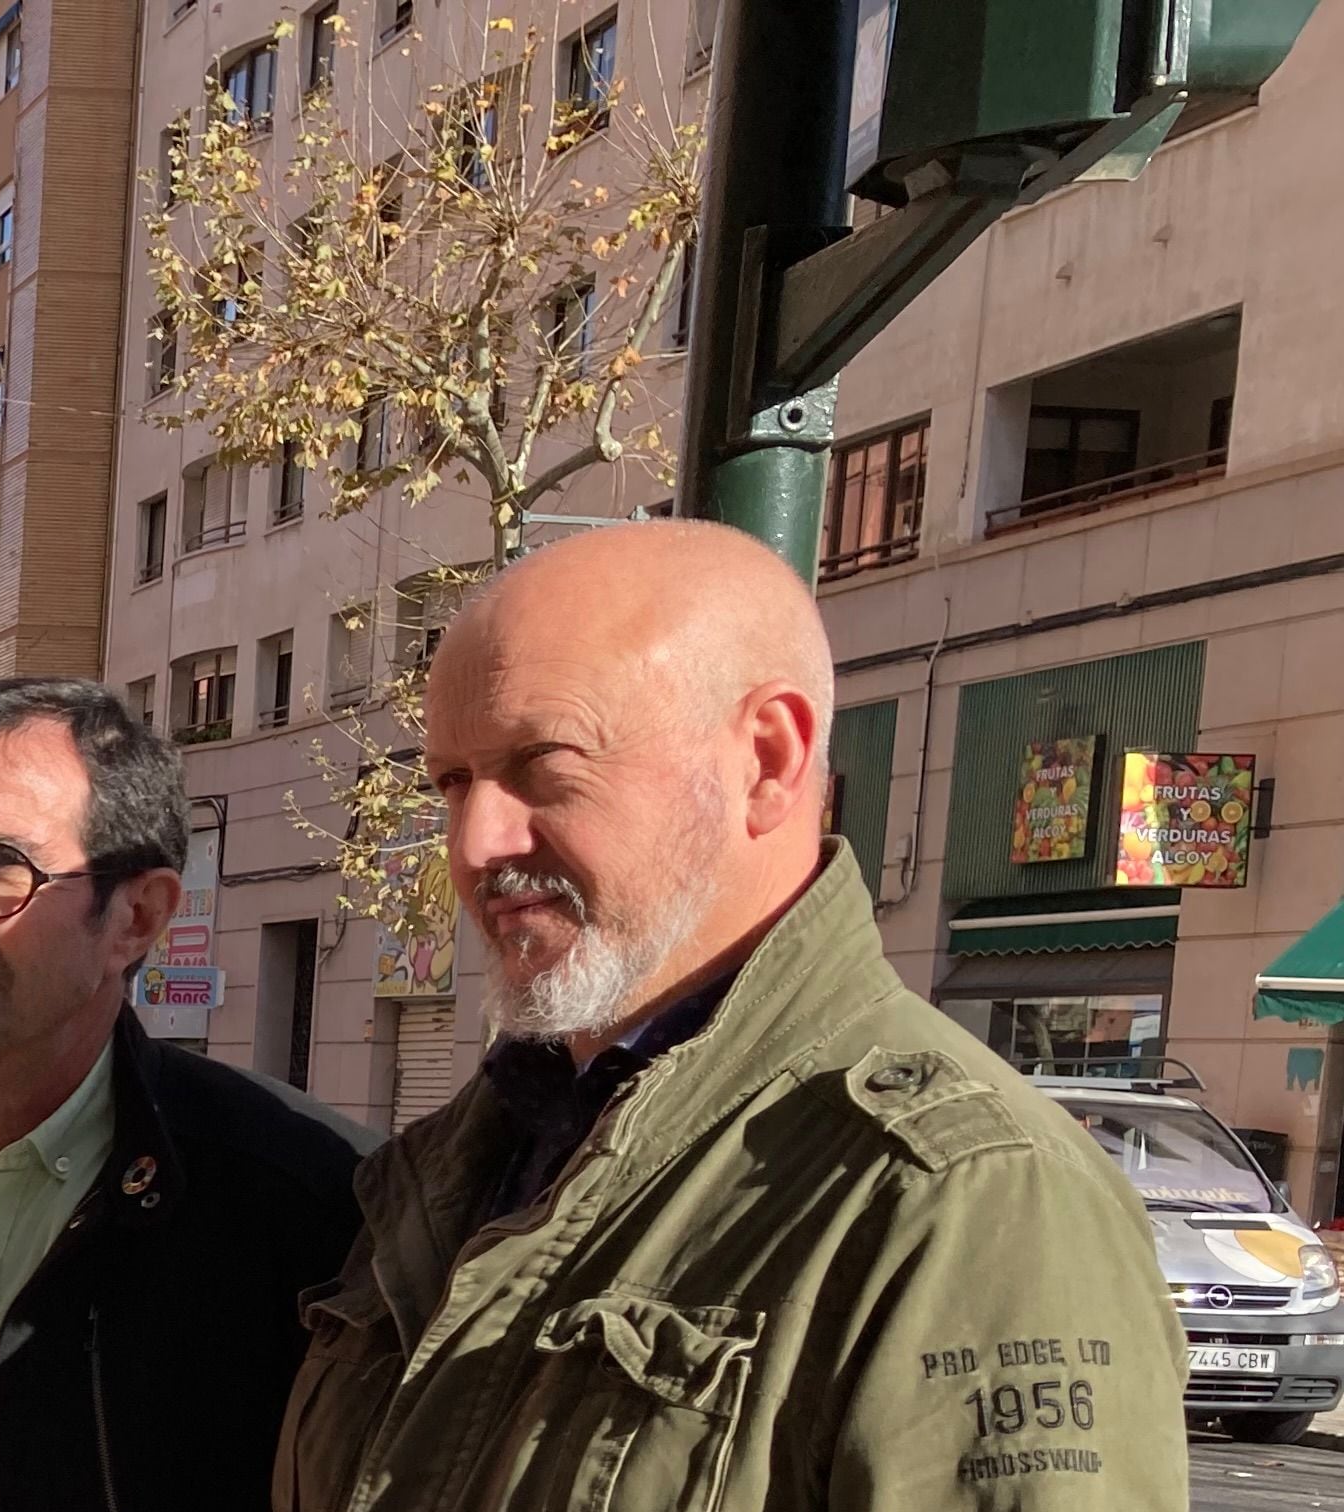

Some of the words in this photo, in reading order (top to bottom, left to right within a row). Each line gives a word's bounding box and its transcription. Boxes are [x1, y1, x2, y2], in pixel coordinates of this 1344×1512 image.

[1035, 766, 1075, 782] FRUTAS
[1153, 785, 1222, 801] FRUTAS
[1025, 803, 1079, 821] VERDURAS
[1180, 807, 1191, 821] Y
[1135, 828, 1232, 845] VERDURAS
[1150, 850, 1212, 865] ALCOY
[921, 1347, 979, 1379] PRO
[1189, 1350, 1231, 1368] 7445
[1237, 1352, 1269, 1369] CBW
[964, 1379, 1095, 1438] 1956
